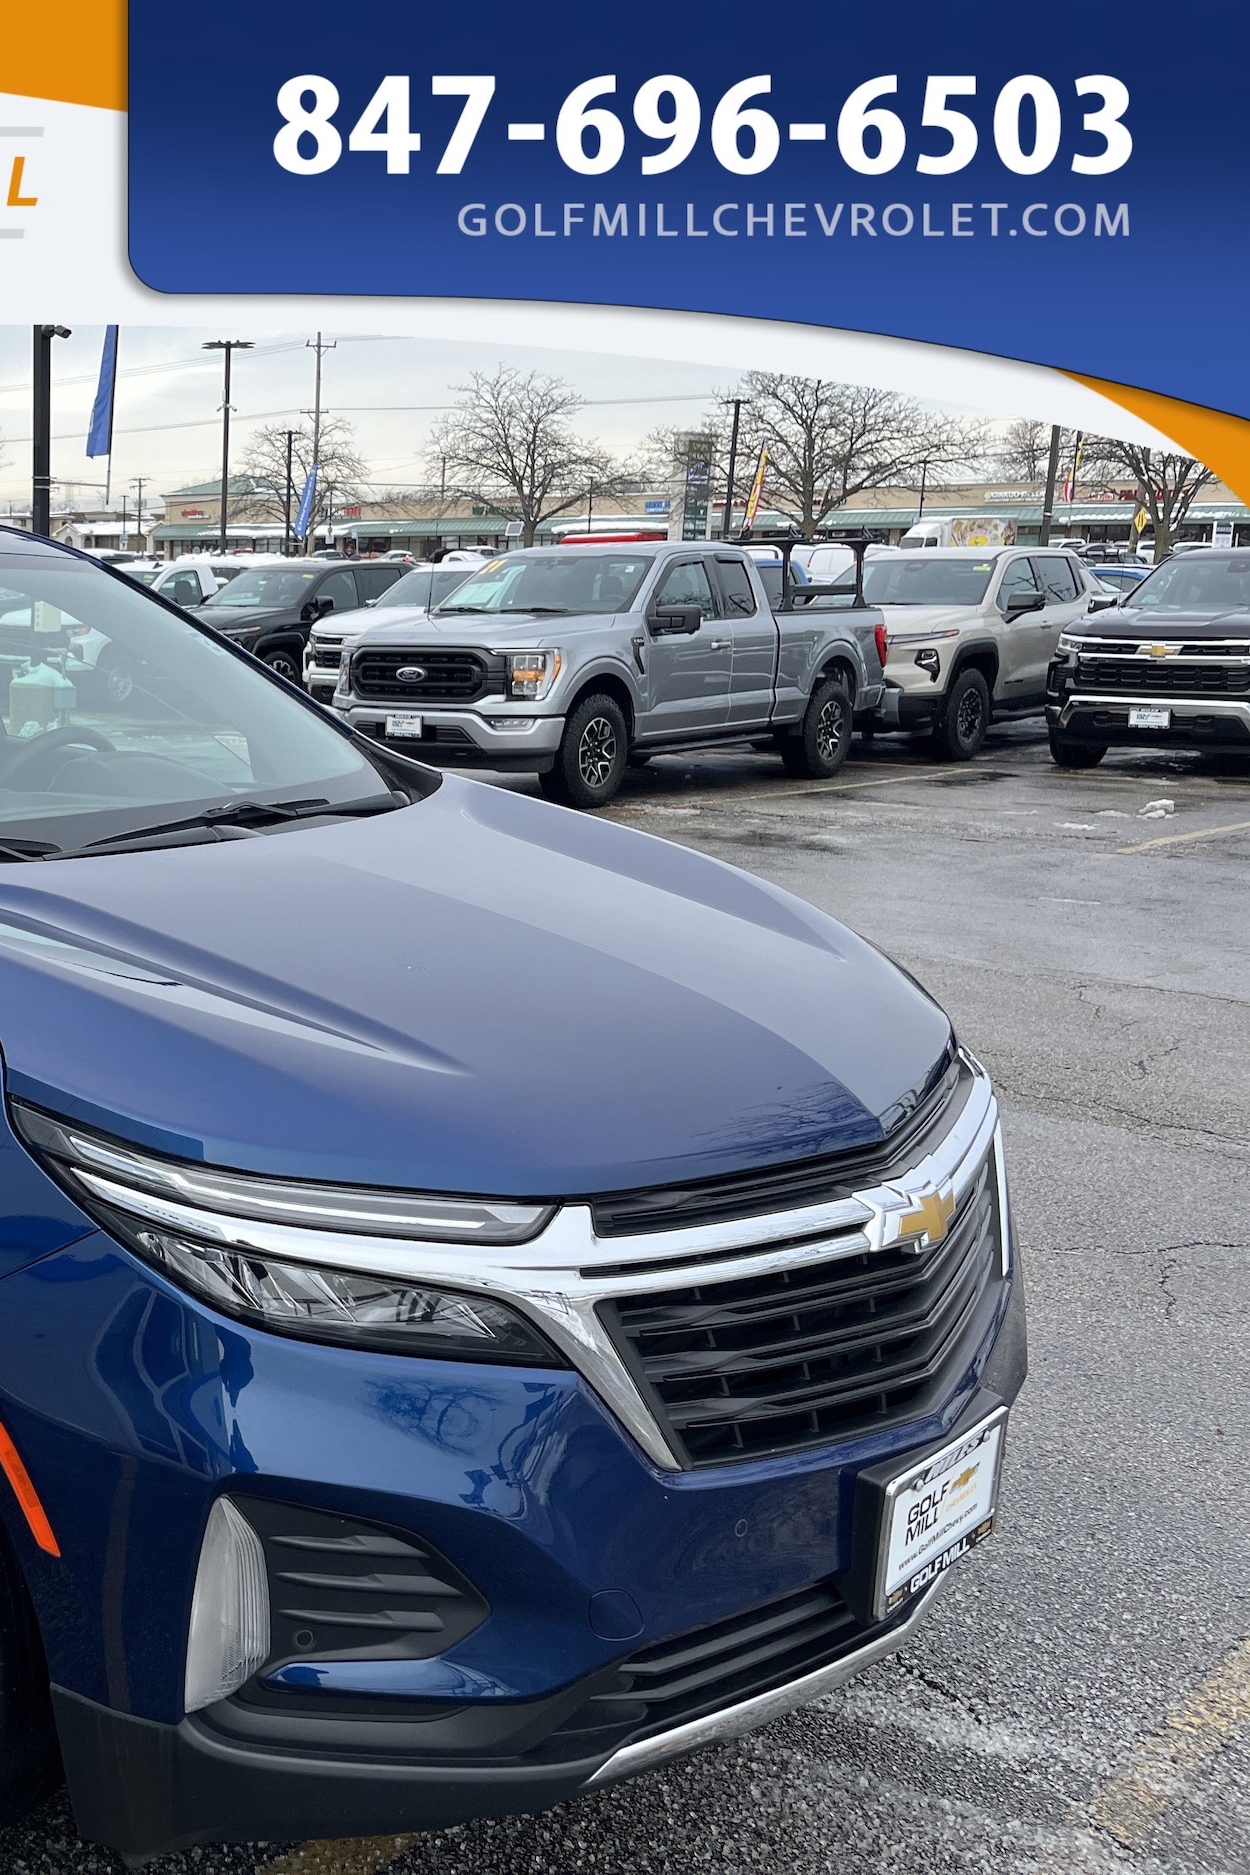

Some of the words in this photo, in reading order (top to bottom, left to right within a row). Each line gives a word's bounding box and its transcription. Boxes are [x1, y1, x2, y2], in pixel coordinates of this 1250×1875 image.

[908, 1479, 951, 1524] GOLF
[904, 1510, 940, 1547] MILL
[910, 1554, 943, 1594] GOLF
[942, 1537, 971, 1569] MILL
